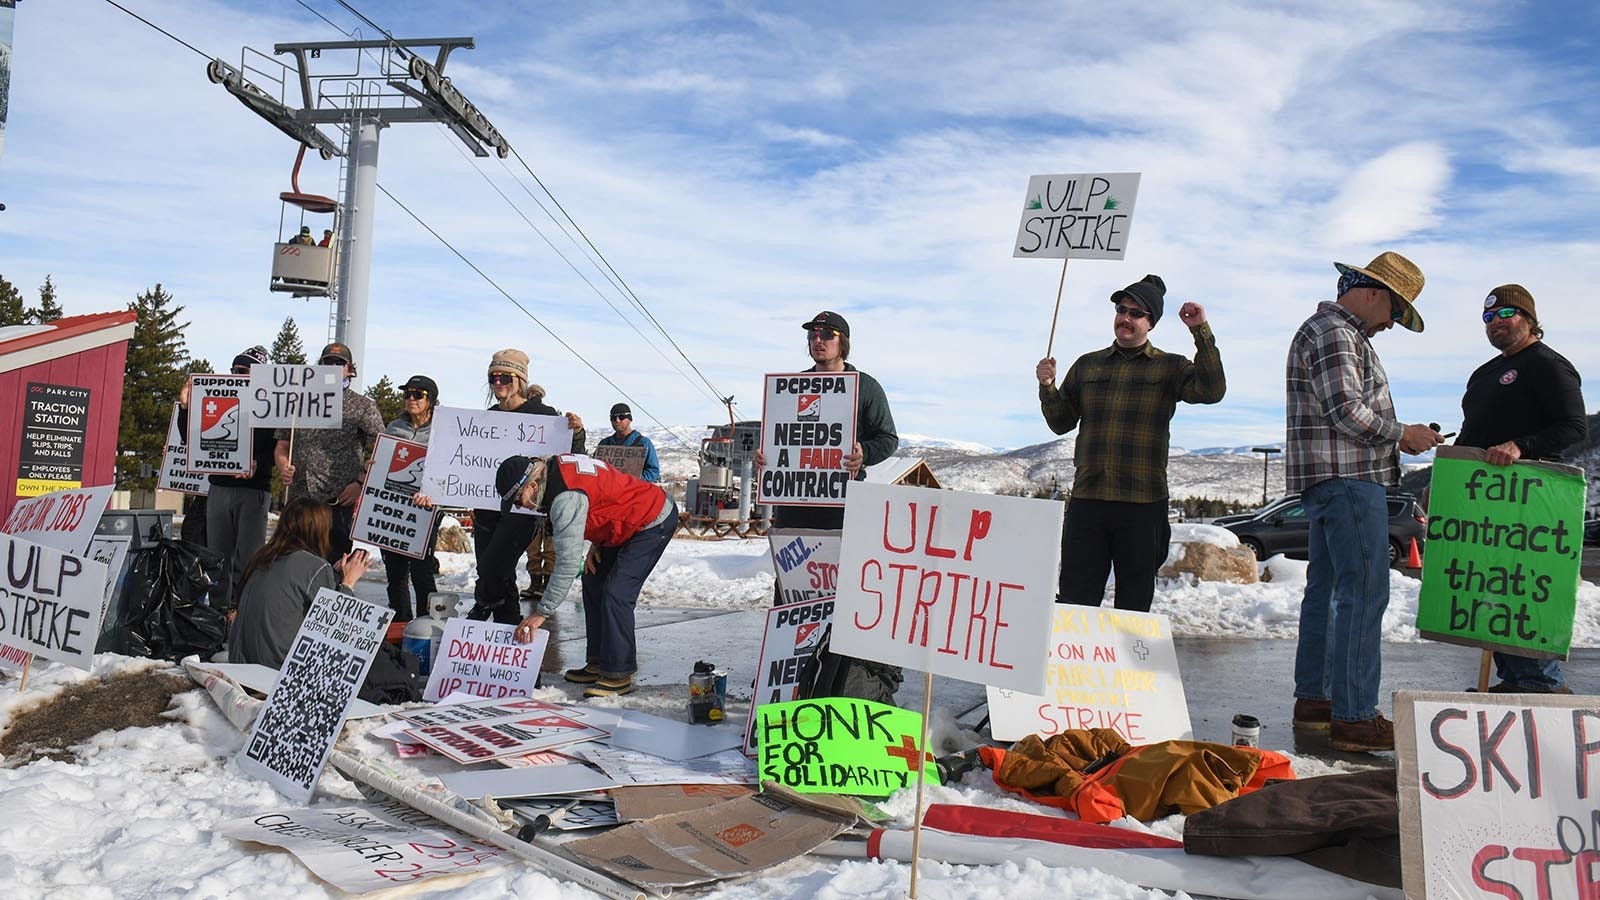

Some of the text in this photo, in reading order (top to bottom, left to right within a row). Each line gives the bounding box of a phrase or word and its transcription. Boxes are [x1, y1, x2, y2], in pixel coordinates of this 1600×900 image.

[1046, 177, 1110, 212] ULP
[1020, 214, 1127, 253] STRIKE
[193, 377, 250, 387] SUPPORT
[273, 367, 315, 388] ULP
[776, 377, 846, 394] PCPSPA
[46, 387, 88, 398] PARK CITY
[205, 389, 239, 397] YOUR
[252, 388, 336, 419] STRIKE
[30, 401, 86, 415] TRACTION
[34, 413, 79, 426] STATION
[46, 434, 82, 443] ELIMINATE
[517, 422, 546, 444] $21
[774, 423, 842, 446] NEEDS
[51, 450, 71, 458] FALLS
[53, 442, 73, 450] TRIPS,
[168, 446, 187, 454] FIG
[597, 447, 647, 458] EXPERIENCE
[31, 465, 71, 473] EMPLOYEES
[173, 457, 187, 466] FO
[195, 460, 242, 470] PATROL
[602, 457, 625, 467] VES
[777, 448, 843, 469] A FAIR
[169, 469, 204, 480] LIVING
[170, 481, 200, 491] WAGE
[763, 470, 849, 498] CONTRACT
[1464, 468, 1543, 504] fair
[365, 486, 433, 512] FIGHTI
[45, 493, 93, 532] JOBS
[373, 503, 417, 523] FOR A
[367, 517, 416, 538] LIVING
[883, 500, 993, 561] ULP
[1426, 515, 1578, 560] contract,
[368, 532, 410, 551] WAGE
[7, 539, 82, 597] ULP
[807, 561, 839, 591] STO
[1444, 558, 1552, 603] that's
[317, 594, 375, 624] our STRIKE
[776, 601, 835, 628] PCPSP
[854, 558, 1025, 670] STRIKE
[1449, 596, 1548, 644] brat.
[308, 604, 376, 640] FUND helps us
[303, 620, 330, 635] afford
[330, 629, 350, 643] FOOD
[354, 638, 379, 654] RENT
[461, 626, 517, 646] IF WE'RE
[448, 639, 532, 669] DOWN HERE
[1057, 642, 1116, 663] ON AN
[451, 661, 521, 682] THEN WHO'S
[438, 678, 527, 699] UP THERE?
[764, 703, 895, 744] HONK
[1037, 703, 1146, 741] STRIKE
[421, 727, 496, 758] STRONG
[460, 724, 525, 749] UNION
[764, 742, 824, 766] FOR
[1422, 708, 1600, 800] SKI P
[764, 764, 908, 788] SOLIDARITY
[1472, 844, 1600, 900] STR
